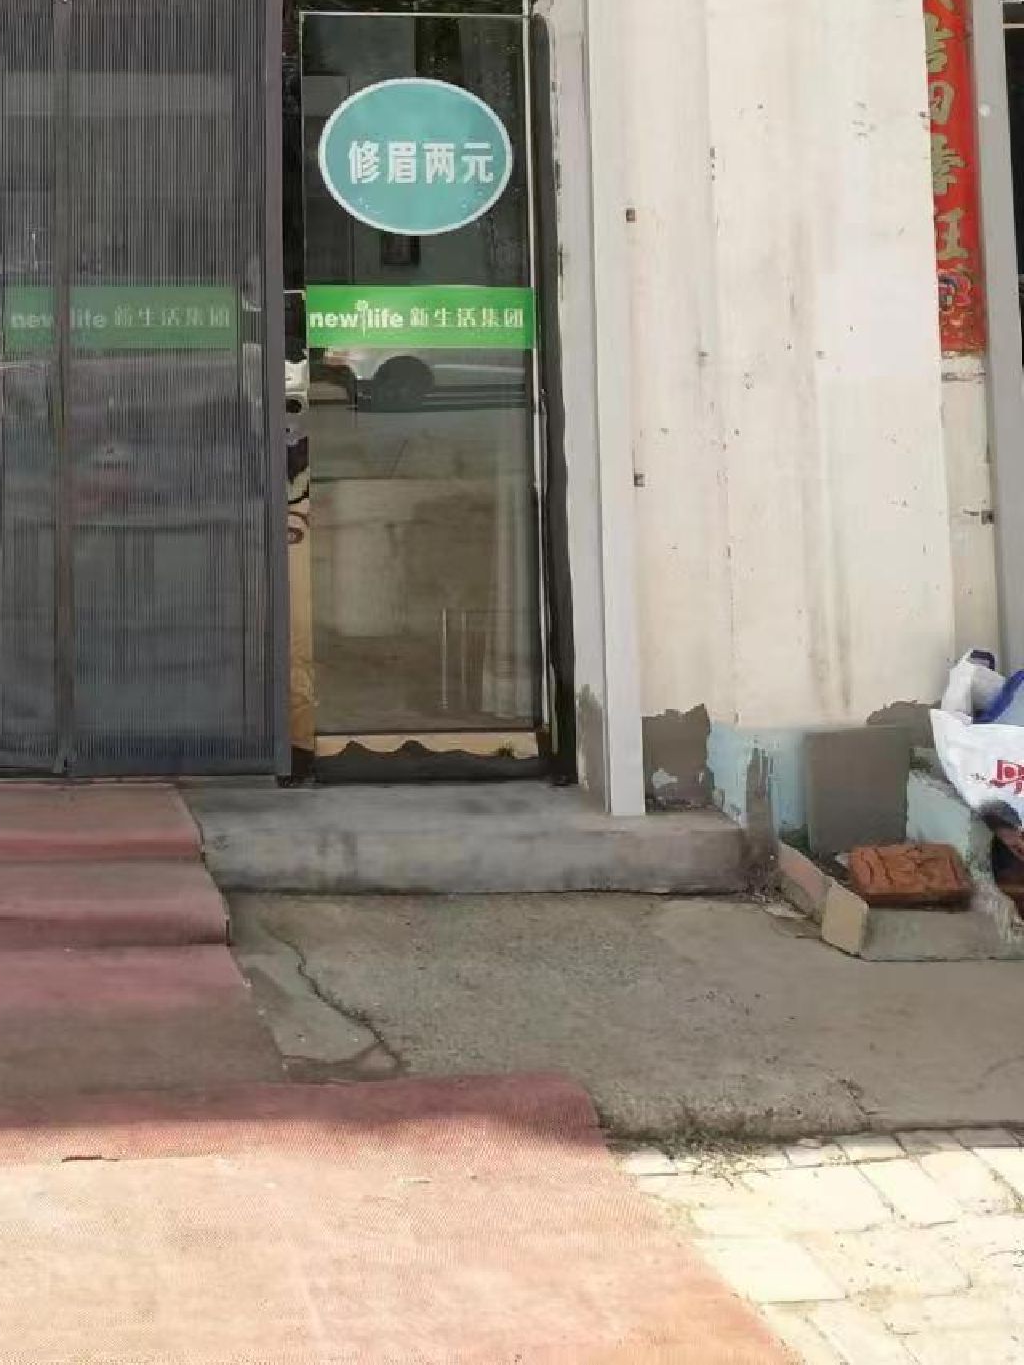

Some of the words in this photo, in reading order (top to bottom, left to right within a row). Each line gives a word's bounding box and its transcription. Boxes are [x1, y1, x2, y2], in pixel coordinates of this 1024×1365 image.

[349, 140, 494, 184] 修眉两元
[409, 307, 524, 329] 新生活集团
